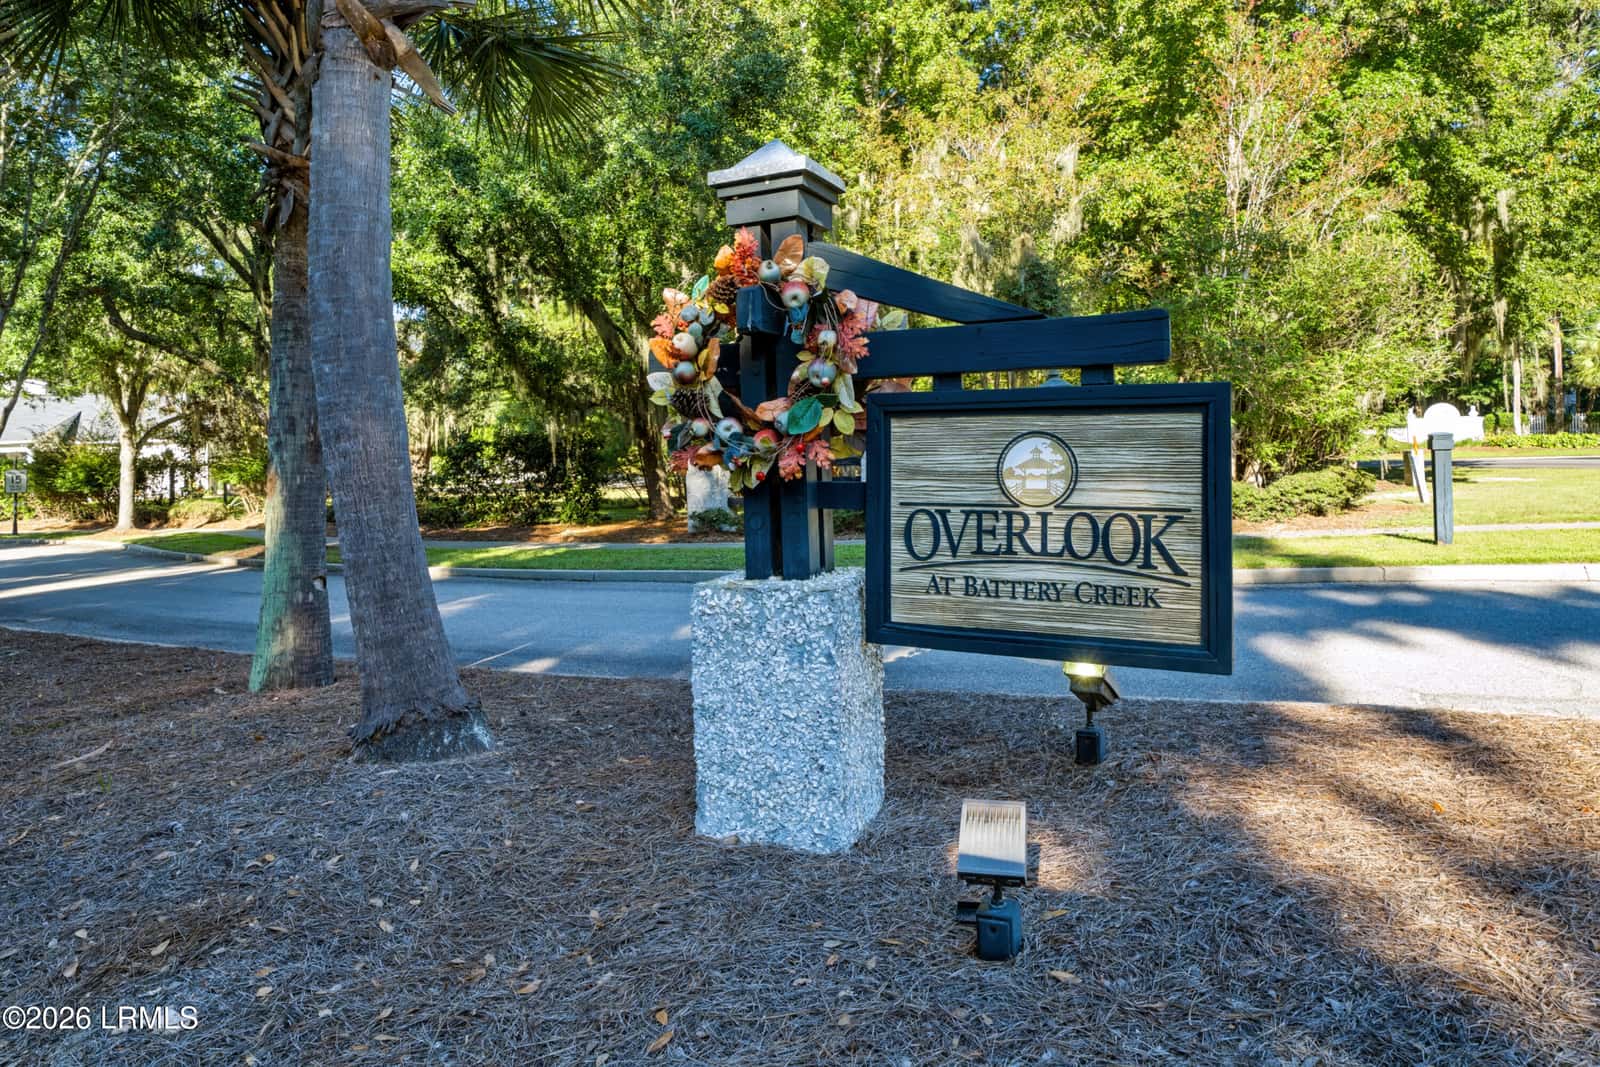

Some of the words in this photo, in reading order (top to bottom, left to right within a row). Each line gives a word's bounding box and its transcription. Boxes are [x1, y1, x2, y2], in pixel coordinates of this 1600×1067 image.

[903, 508, 1189, 577] OVERLOOK
[926, 574, 955, 596] AT
[963, 575, 1067, 603] BATTERY
[1074, 581, 1163, 610] CREEK
